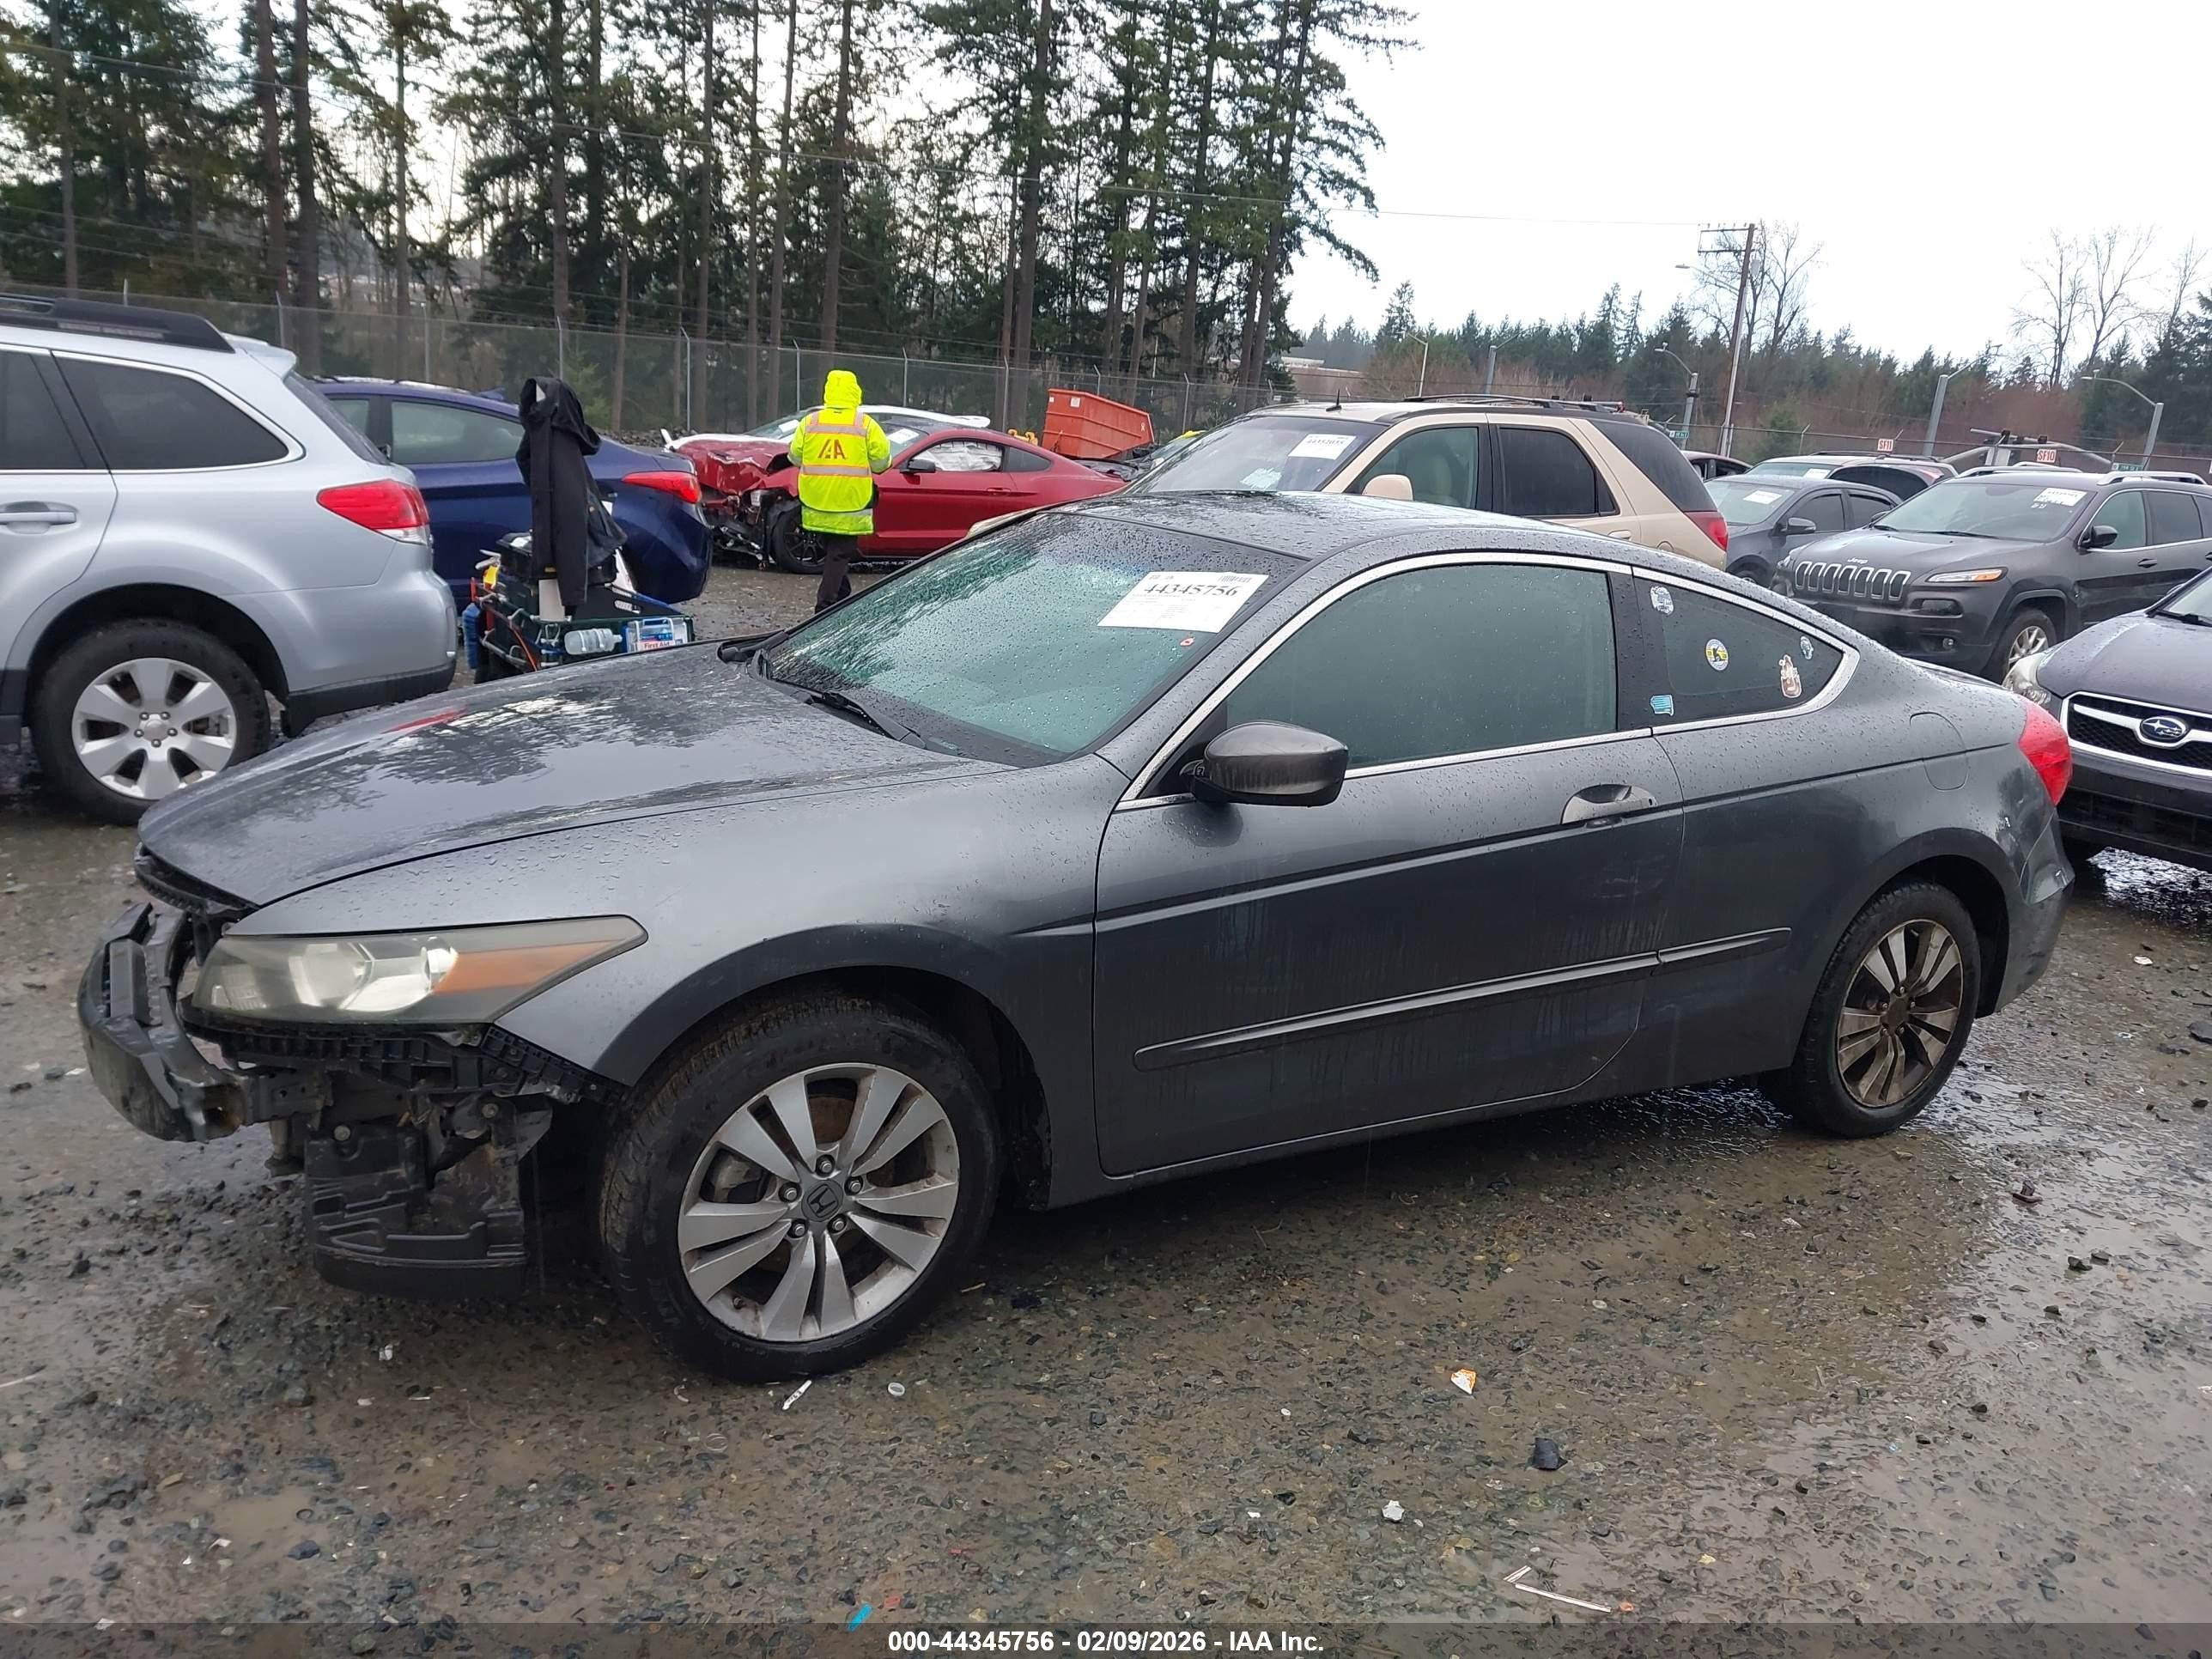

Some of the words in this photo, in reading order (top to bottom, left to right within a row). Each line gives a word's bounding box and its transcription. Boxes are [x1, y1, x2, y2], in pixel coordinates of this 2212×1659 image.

[1879, 440, 1893, 450] SF11
[2038, 449, 2056, 461] SF10
[1144, 583, 1243, 597] 44345756
